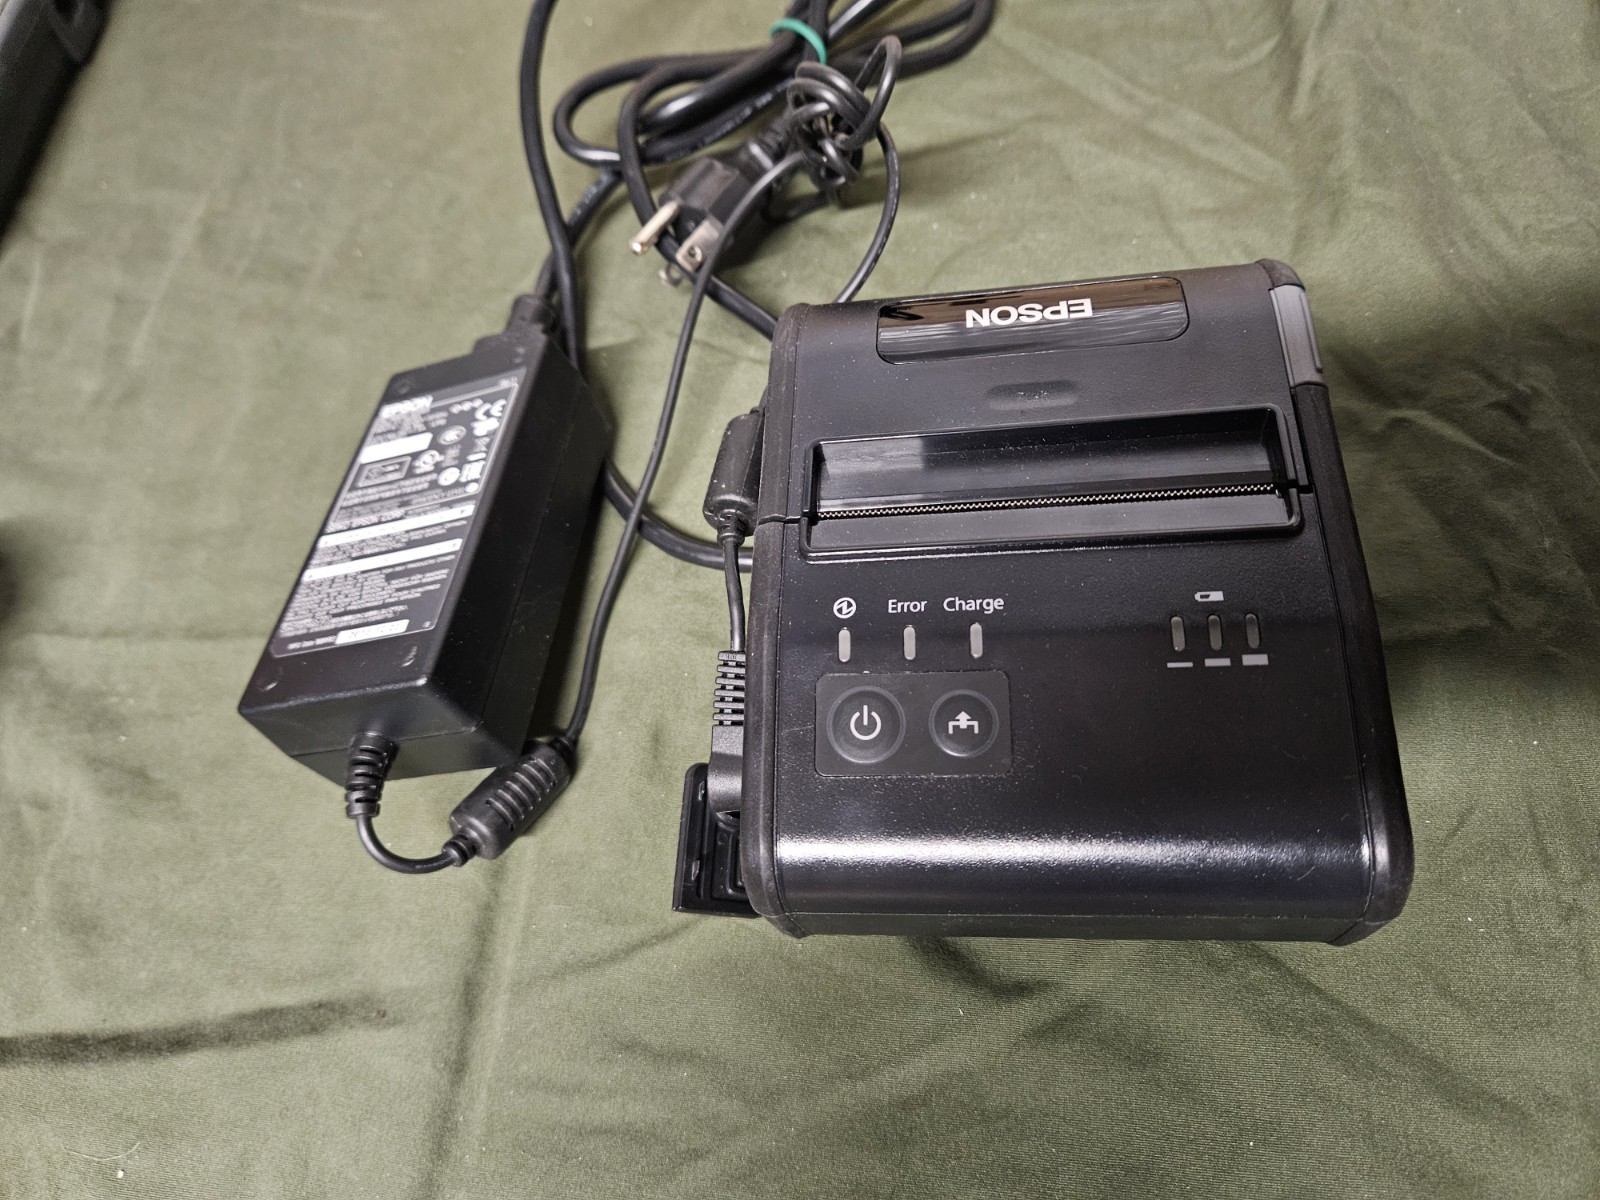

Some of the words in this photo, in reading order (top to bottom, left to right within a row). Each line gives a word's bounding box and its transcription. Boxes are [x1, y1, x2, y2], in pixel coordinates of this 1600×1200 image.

[965, 298, 1093, 328] EPSON
[887, 599, 928, 614] Error
[943, 596, 1005, 615] Charge
